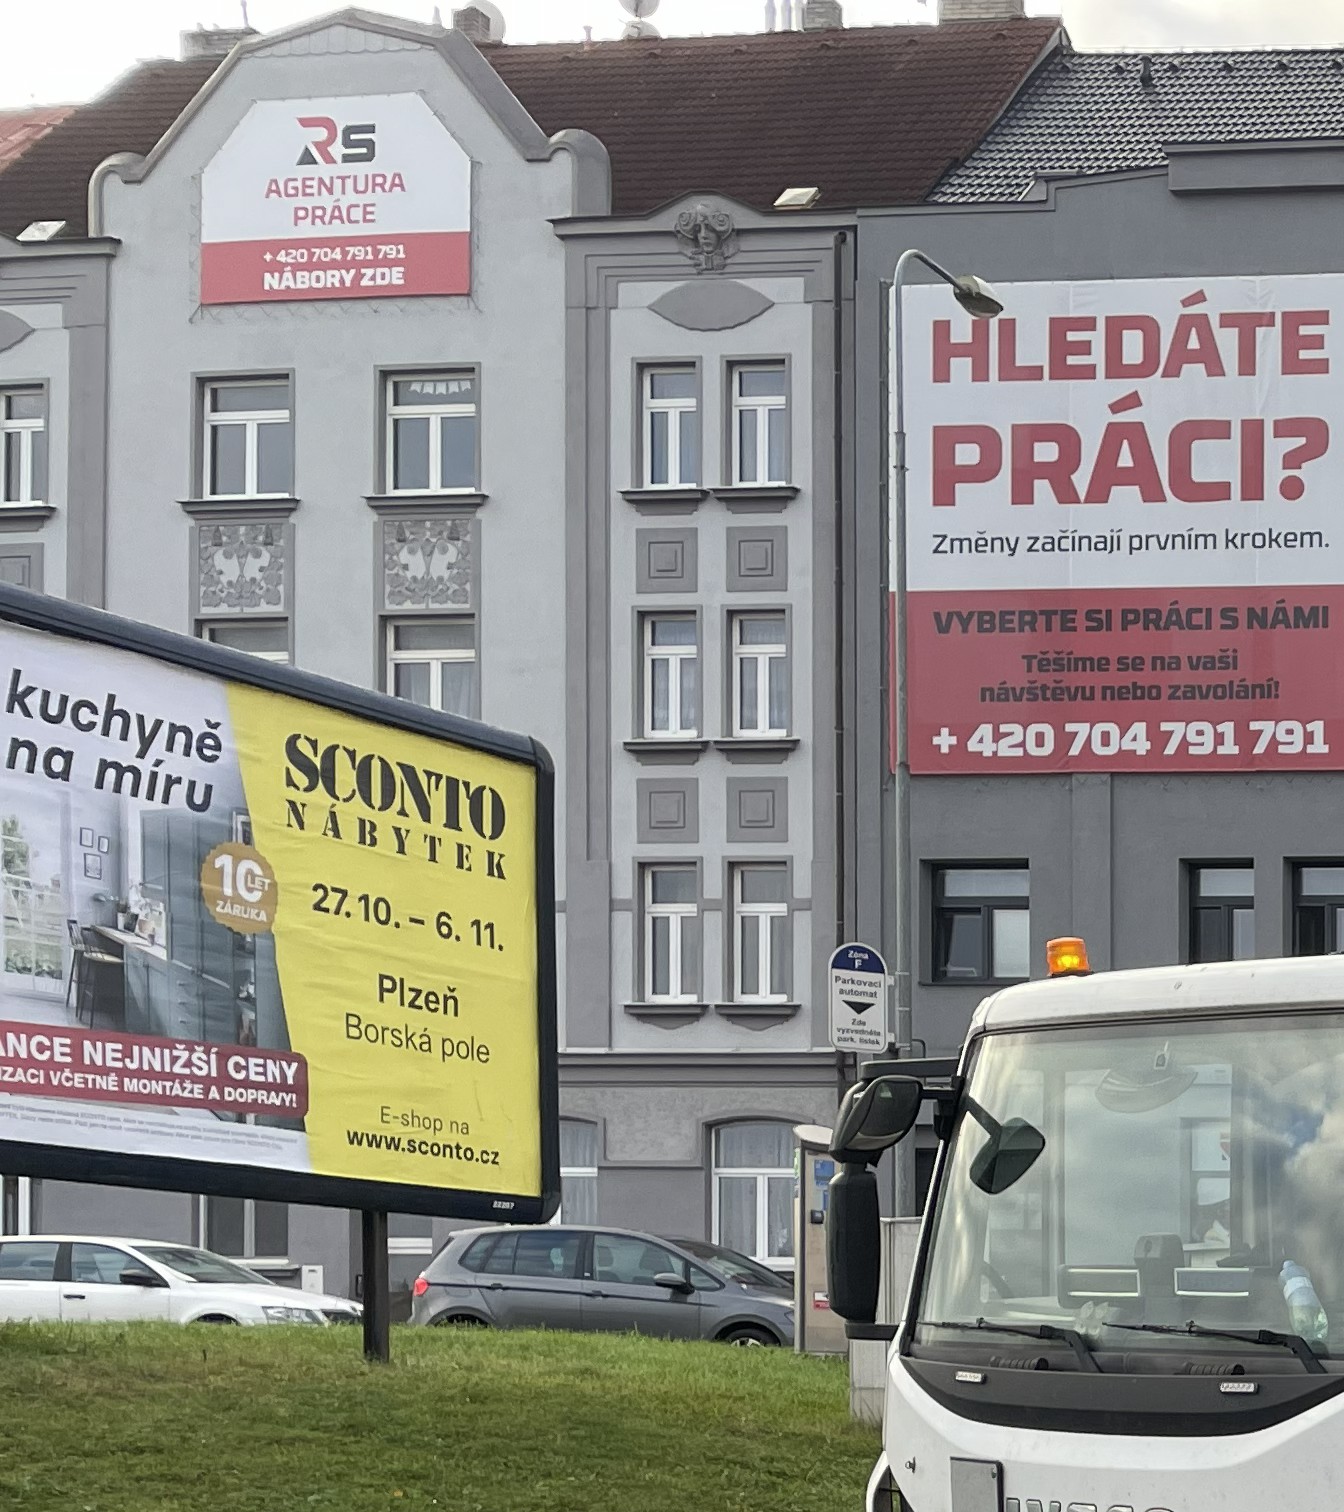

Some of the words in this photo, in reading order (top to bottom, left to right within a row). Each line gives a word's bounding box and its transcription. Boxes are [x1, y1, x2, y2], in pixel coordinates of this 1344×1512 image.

[296, 116, 376, 166] RS
[265, 172, 406, 198] AGENTURA
[293, 199, 376, 226] PRÁCE
[276, 249, 308, 263] 420
[311, 247, 342, 262] 704
[346, 246, 374, 261] 791
[377, 245, 405, 259] 791
[264, 266, 356, 290] NÁBORY
[360, 267, 405, 286] ZDE
[932, 289, 1330, 383] HLEDÁTE
[932, 390, 1329, 506] PRÁCI?
[933, 530, 1019, 556] Změny
[1027, 529, 1123, 556] začínají
[1129, 528, 1217, 555] prvním
[1224, 528, 1330, 550] krokem.
[933, 609, 1078, 634] VYBERTE
[1086, 609, 1111, 632] SI
[1121, 600, 1213, 631] PRÁCI
[1220, 607, 1239, 630] S
[1247, 599, 1329, 630] NÁMI
[1022, 650, 1110, 673] Těšíme
[1117, 655, 1145, 672] se
[1152, 655, 1181, 672] na
[1187, 648, 1238, 671] vaši
[980, 680, 1096, 703] návštěvu
[1102, 681, 1161, 701] nebo
[1168, 677, 1280, 701] zavolání!
[5, 668, 222, 763] kuchyně
[967, 723, 1054, 757] 420
[1065, 722, 1151, 755] 704
[1160, 721, 1239, 755] 791
[1249, 720, 1329, 754] 791
[5, 736, 74, 781] na
[94, 758, 213, 812] míru
[285, 733, 506, 840] SCONTO
[286, 799, 506, 880] NÁBYTEK
[214, 854, 263, 902] 10
[247, 871, 271, 892] LET
[216, 900, 267, 922] ZÁRUKA
[378, 973, 459, 1017] Plzeň
[839, 988, 878, 999] automat
[346, 1012, 431, 1053] Borská
[442, 1036, 490, 1063] pole
[83, 1040, 218, 1077] NEJNIŽŠÍ
[227, 1055, 298, 1085] CENY
[49, 1068, 118, 1091] VČETNĚ
[123, 1077, 203, 1100] MONTÁŽE
[208, 1086, 220, 1100] A
[224, 1089, 297, 1108] DOPRAVY!
[380, 1106, 443, 1135] E-shop
[451, 1119, 469, 1134] na
[347, 1130, 499, 1165] www.sconto.cz
